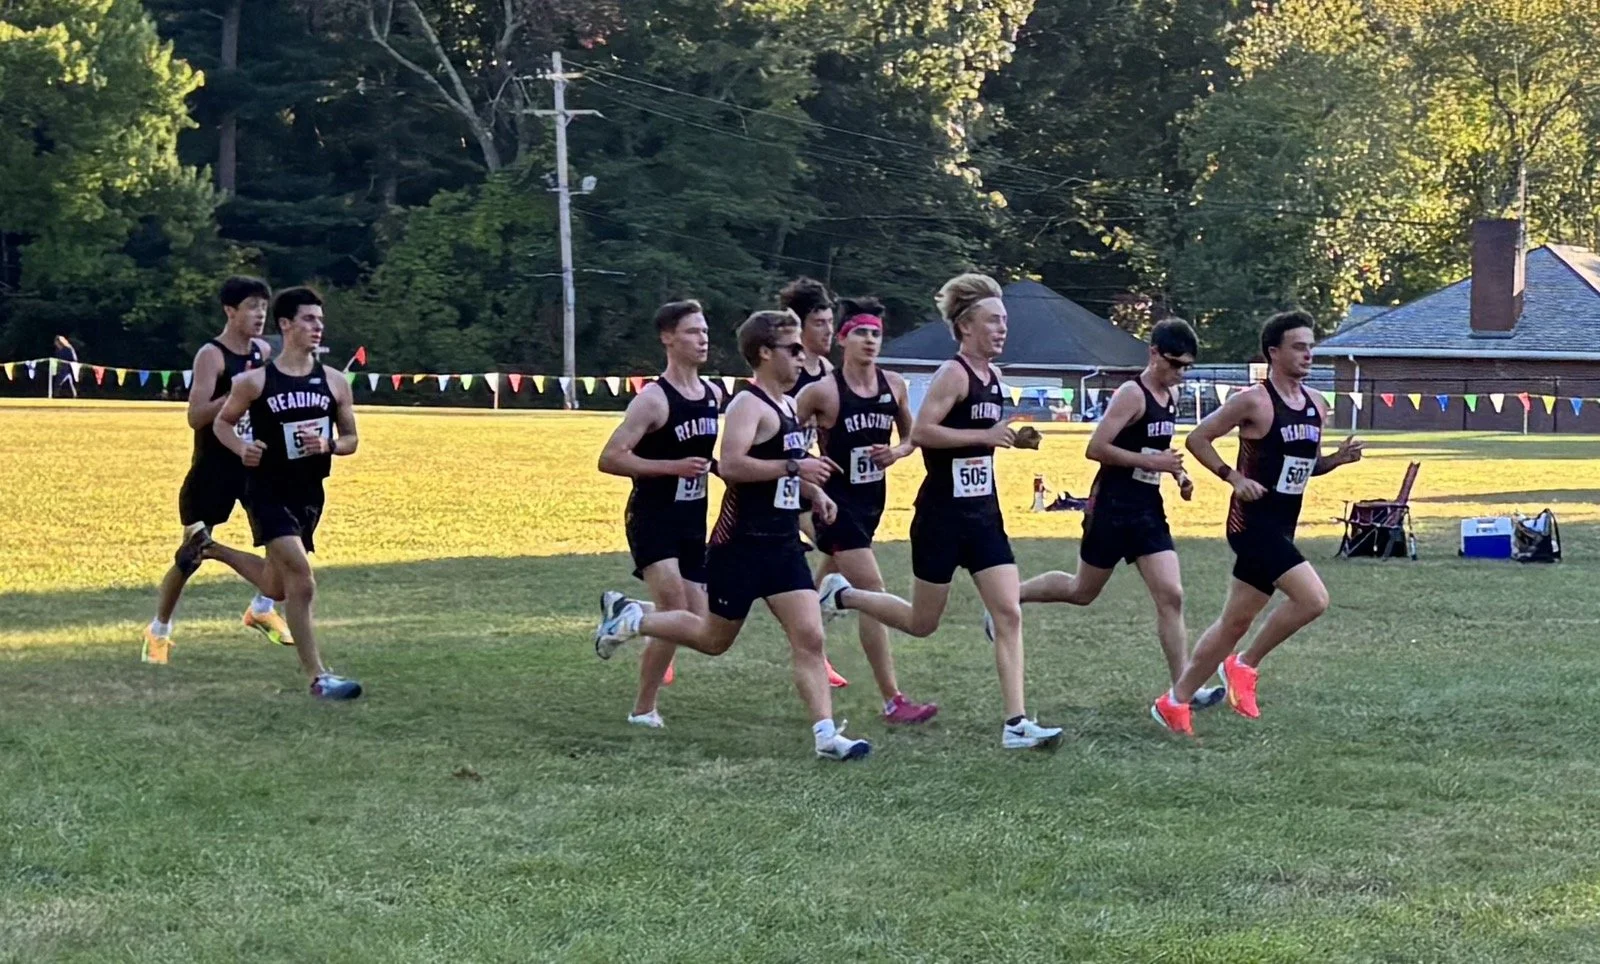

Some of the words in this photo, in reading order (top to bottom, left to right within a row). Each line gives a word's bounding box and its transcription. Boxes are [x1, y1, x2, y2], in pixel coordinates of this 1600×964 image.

[267, 391, 331, 413] READING
[293, 426, 324, 449] 57
[959, 466, 988, 486] 505
